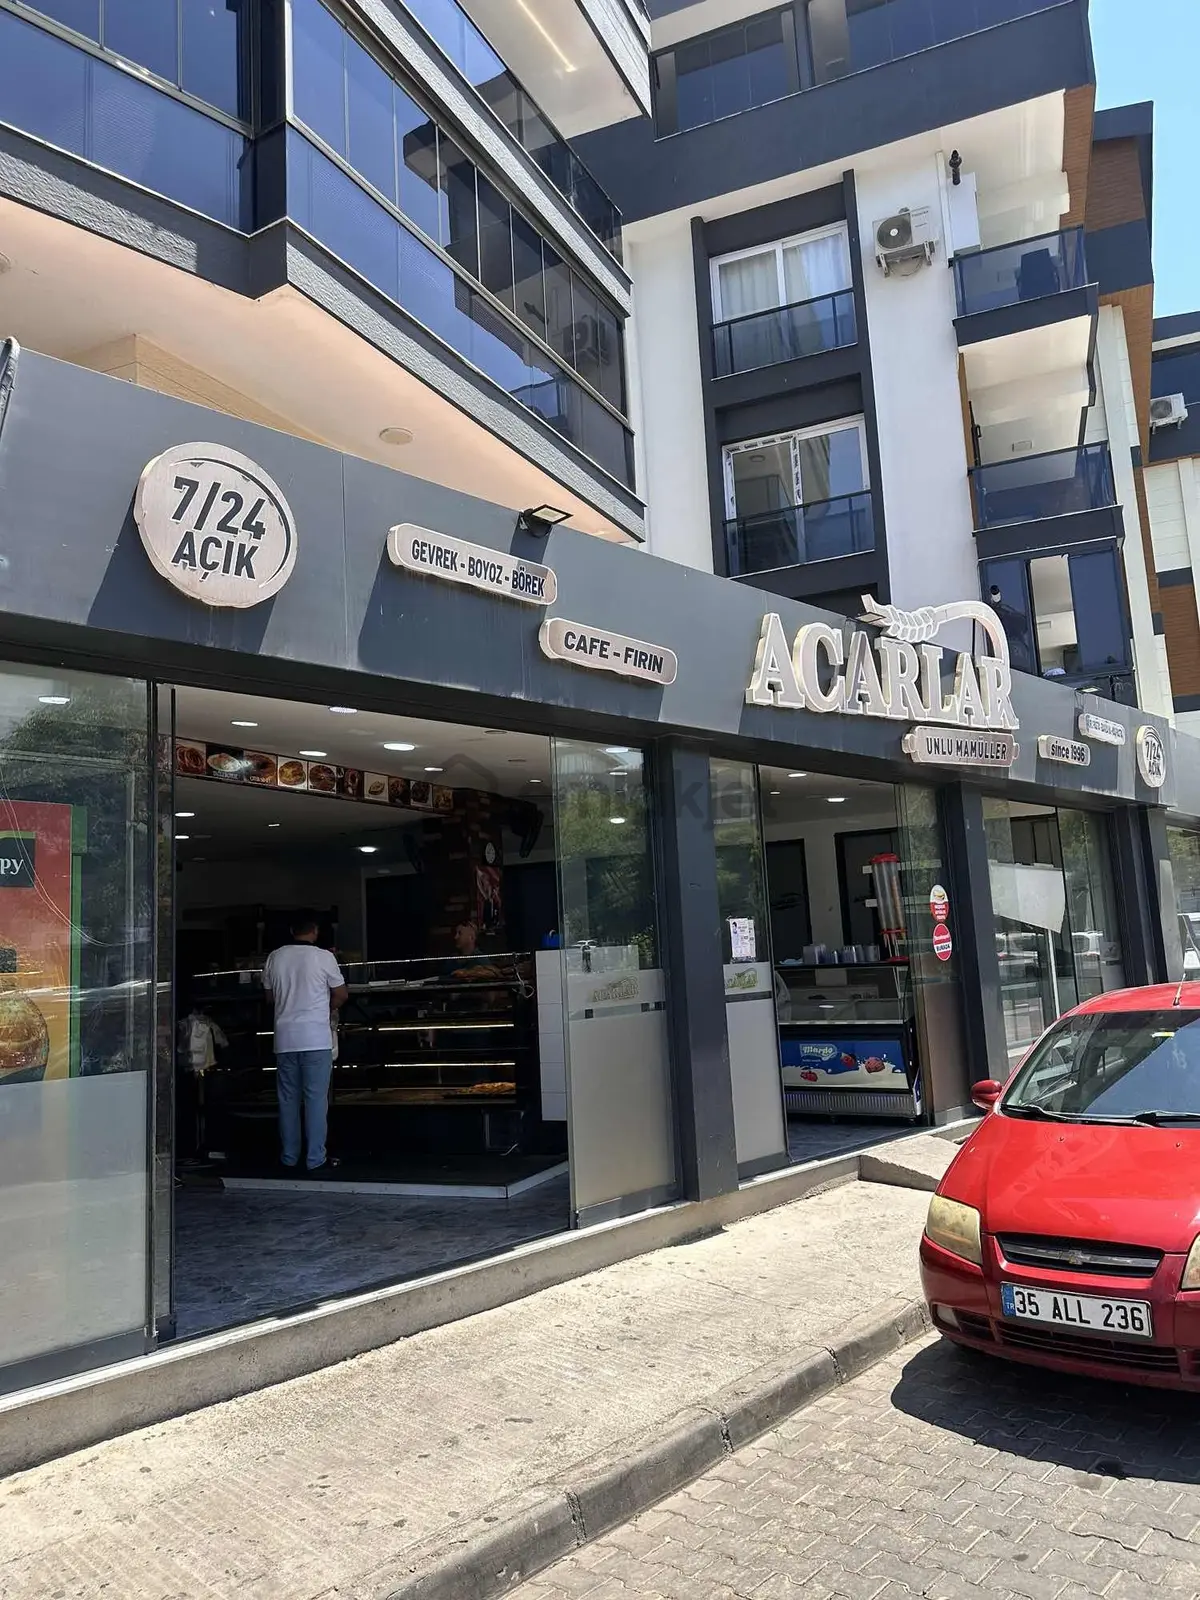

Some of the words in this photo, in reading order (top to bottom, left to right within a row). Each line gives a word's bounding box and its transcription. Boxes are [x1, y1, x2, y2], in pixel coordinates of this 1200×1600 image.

[171, 476, 266, 540] 7/24
[171, 531, 259, 580] AÇIK
[412, 539, 458, 572] GEVREK
[468, 557, 503, 585] BOYOZ
[512, 566, 545, 597] BÖREK
[564, 631, 610, 659] CAFE
[624, 647, 663, 673] FIRIN
[746, 612, 1019, 730] ACARLAR
[926, 737, 953, 755] UNLU
[956, 737, 1007, 760] MAMÜLLER
[1051, 741, 1069, 760] since
[1070, 744, 1085, 762] 1996
[1145, 741, 1161, 761] 7/24
[1015, 1290, 1040, 1316] 35
[1052, 1296, 1091, 1325] ALL
[1101, 1303, 1144, 1332] 236
